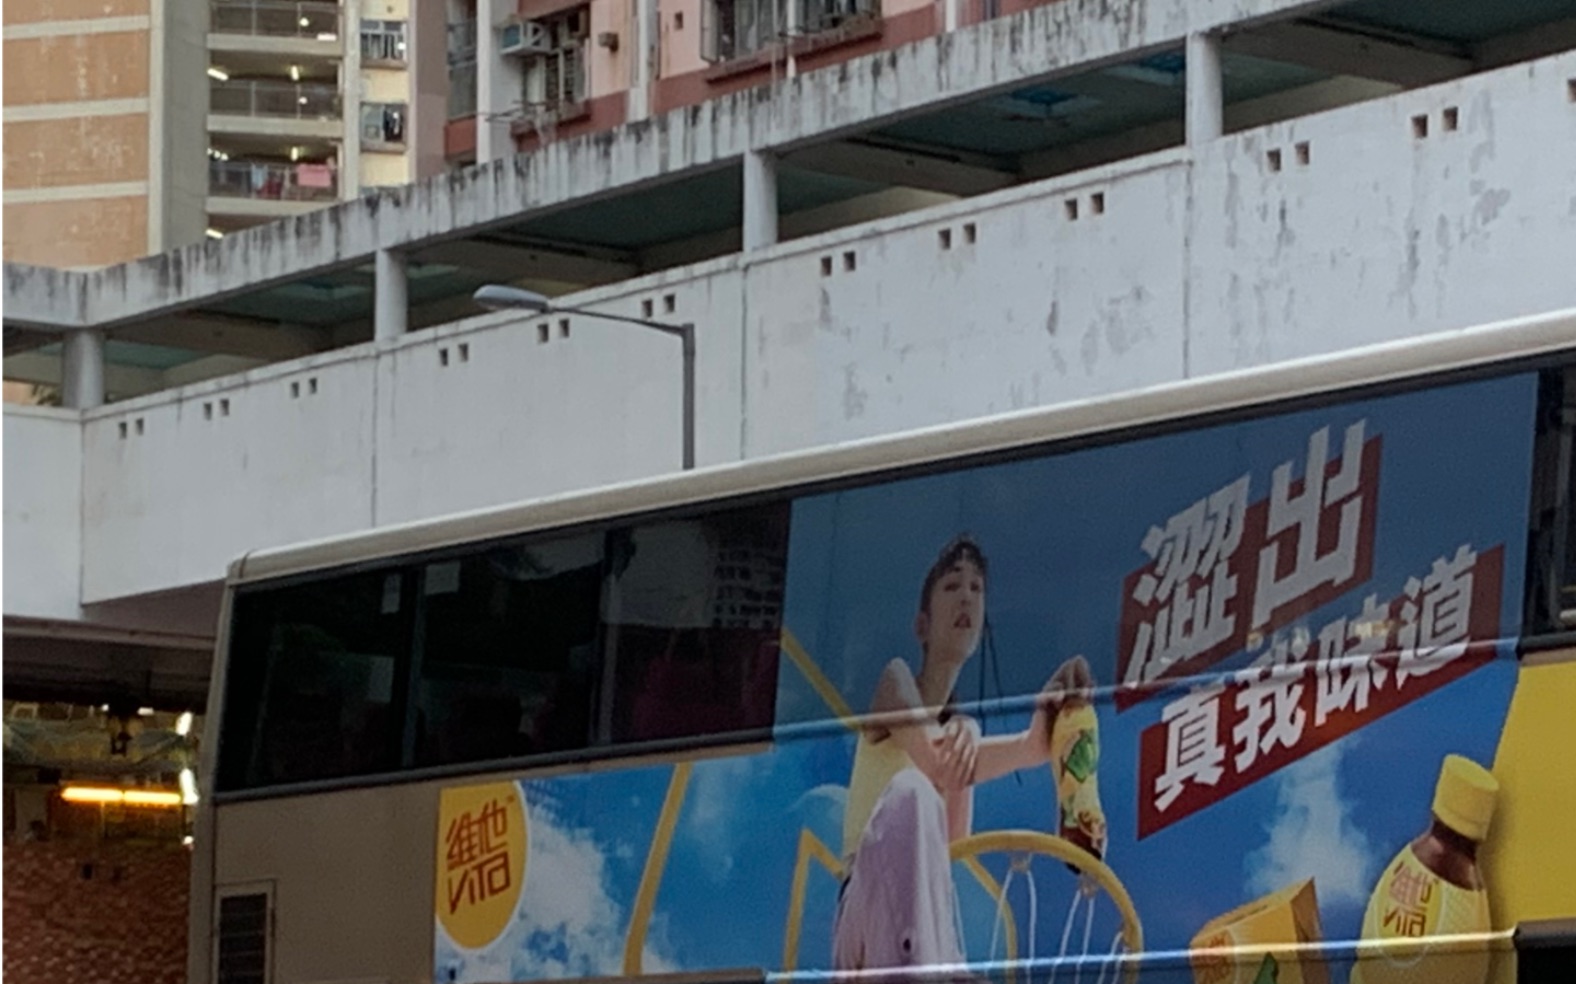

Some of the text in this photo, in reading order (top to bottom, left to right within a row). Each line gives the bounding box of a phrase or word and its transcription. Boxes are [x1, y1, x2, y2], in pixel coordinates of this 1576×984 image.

[1155, 545, 1477, 812] 真我味道
[446, 799, 507, 871] 維他
